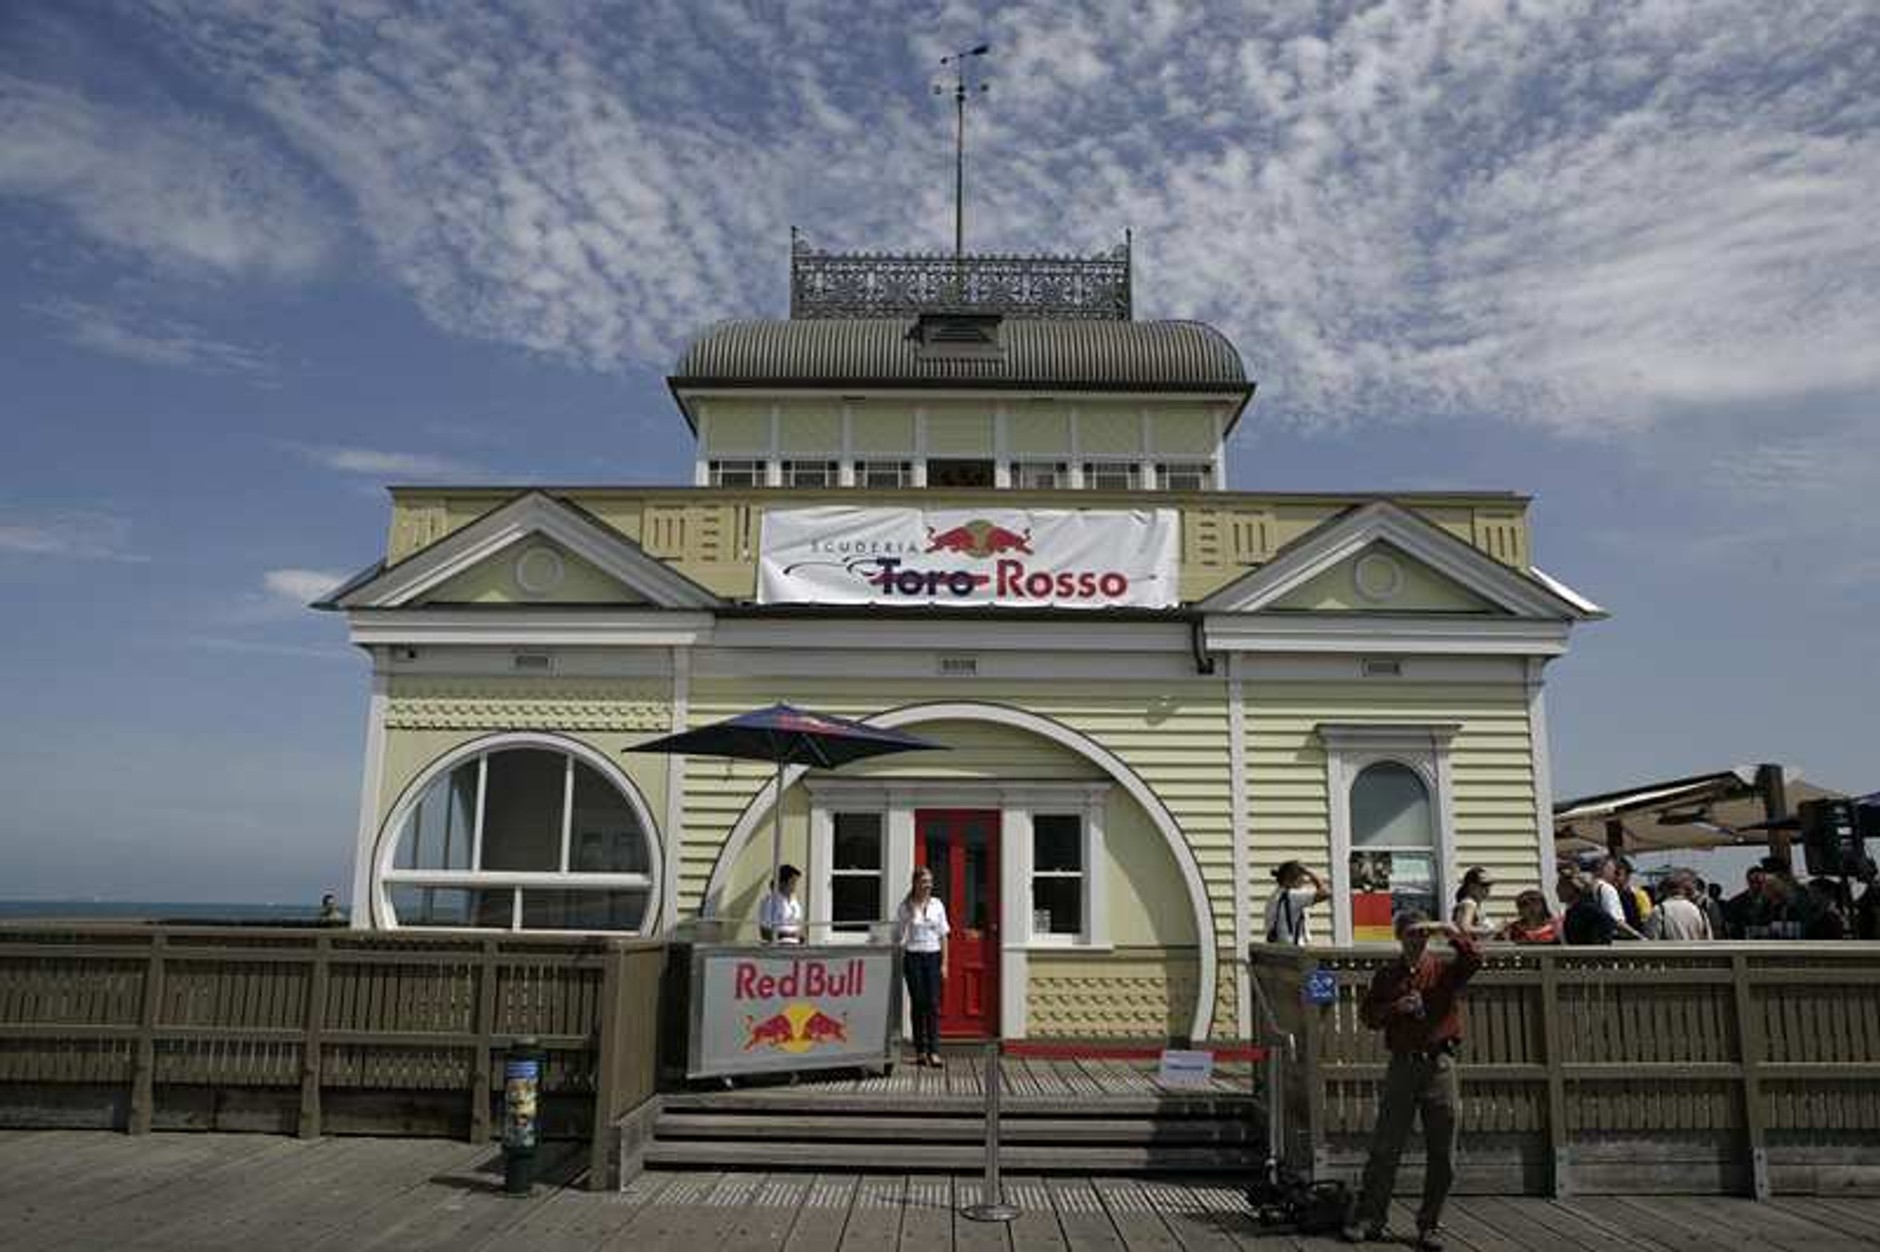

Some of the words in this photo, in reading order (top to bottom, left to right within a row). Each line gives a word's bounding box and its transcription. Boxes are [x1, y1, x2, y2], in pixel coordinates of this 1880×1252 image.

[810, 539, 920, 555] SCUDERIA
[876, 557, 976, 598] Toro
[996, 558, 1129, 599] Rosso
[734, 959, 800, 1000] Red
[805, 958, 865, 998] Bull
